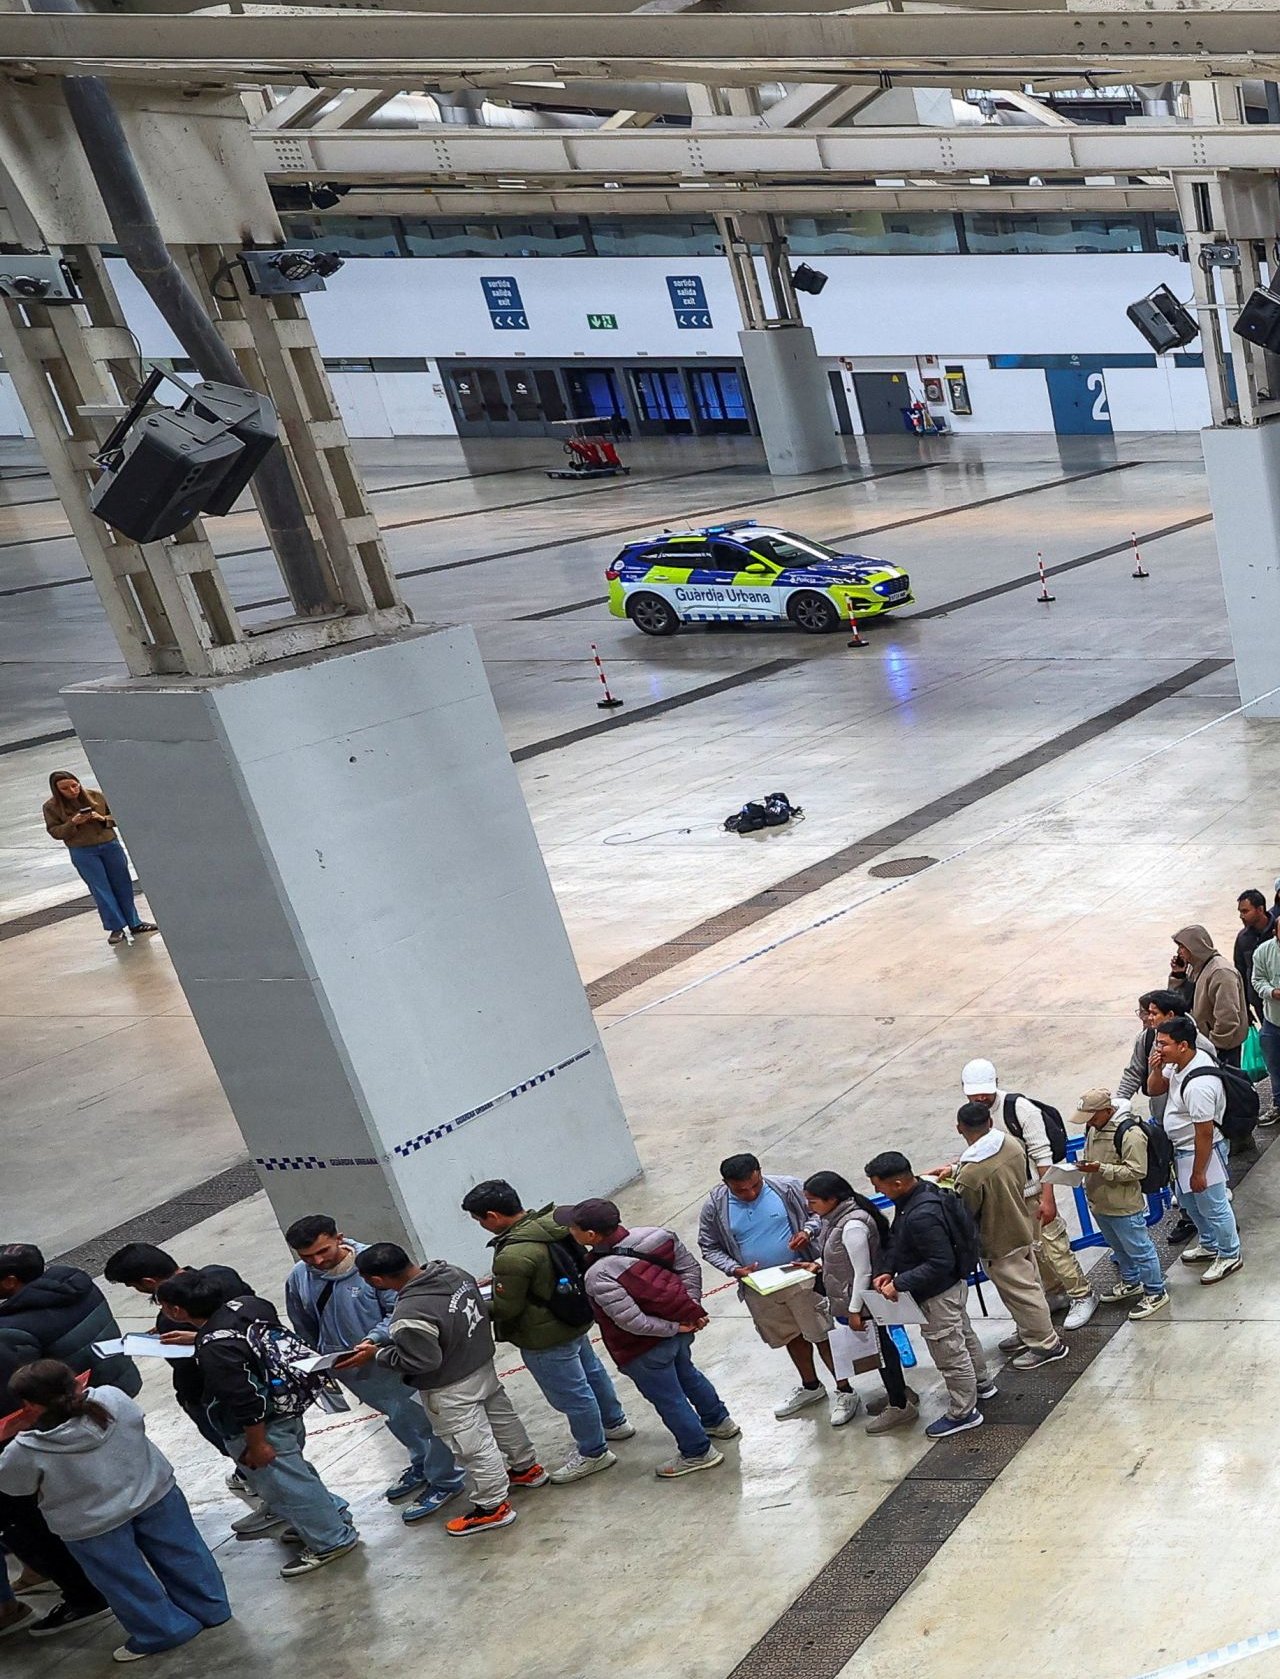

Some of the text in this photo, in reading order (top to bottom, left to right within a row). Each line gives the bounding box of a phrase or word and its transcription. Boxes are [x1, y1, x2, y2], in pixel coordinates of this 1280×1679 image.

[488, 280, 511, 288] sortida
[673, 279, 696, 287] sortida
[492, 289, 512, 297] salida
[676, 288, 697, 296] salida
[498, 298, 511, 306] exit
[683, 297, 696, 305] exit
[1087, 373, 1110, 420] 2
[675, 587, 771, 603] Guàrdia Urbana
